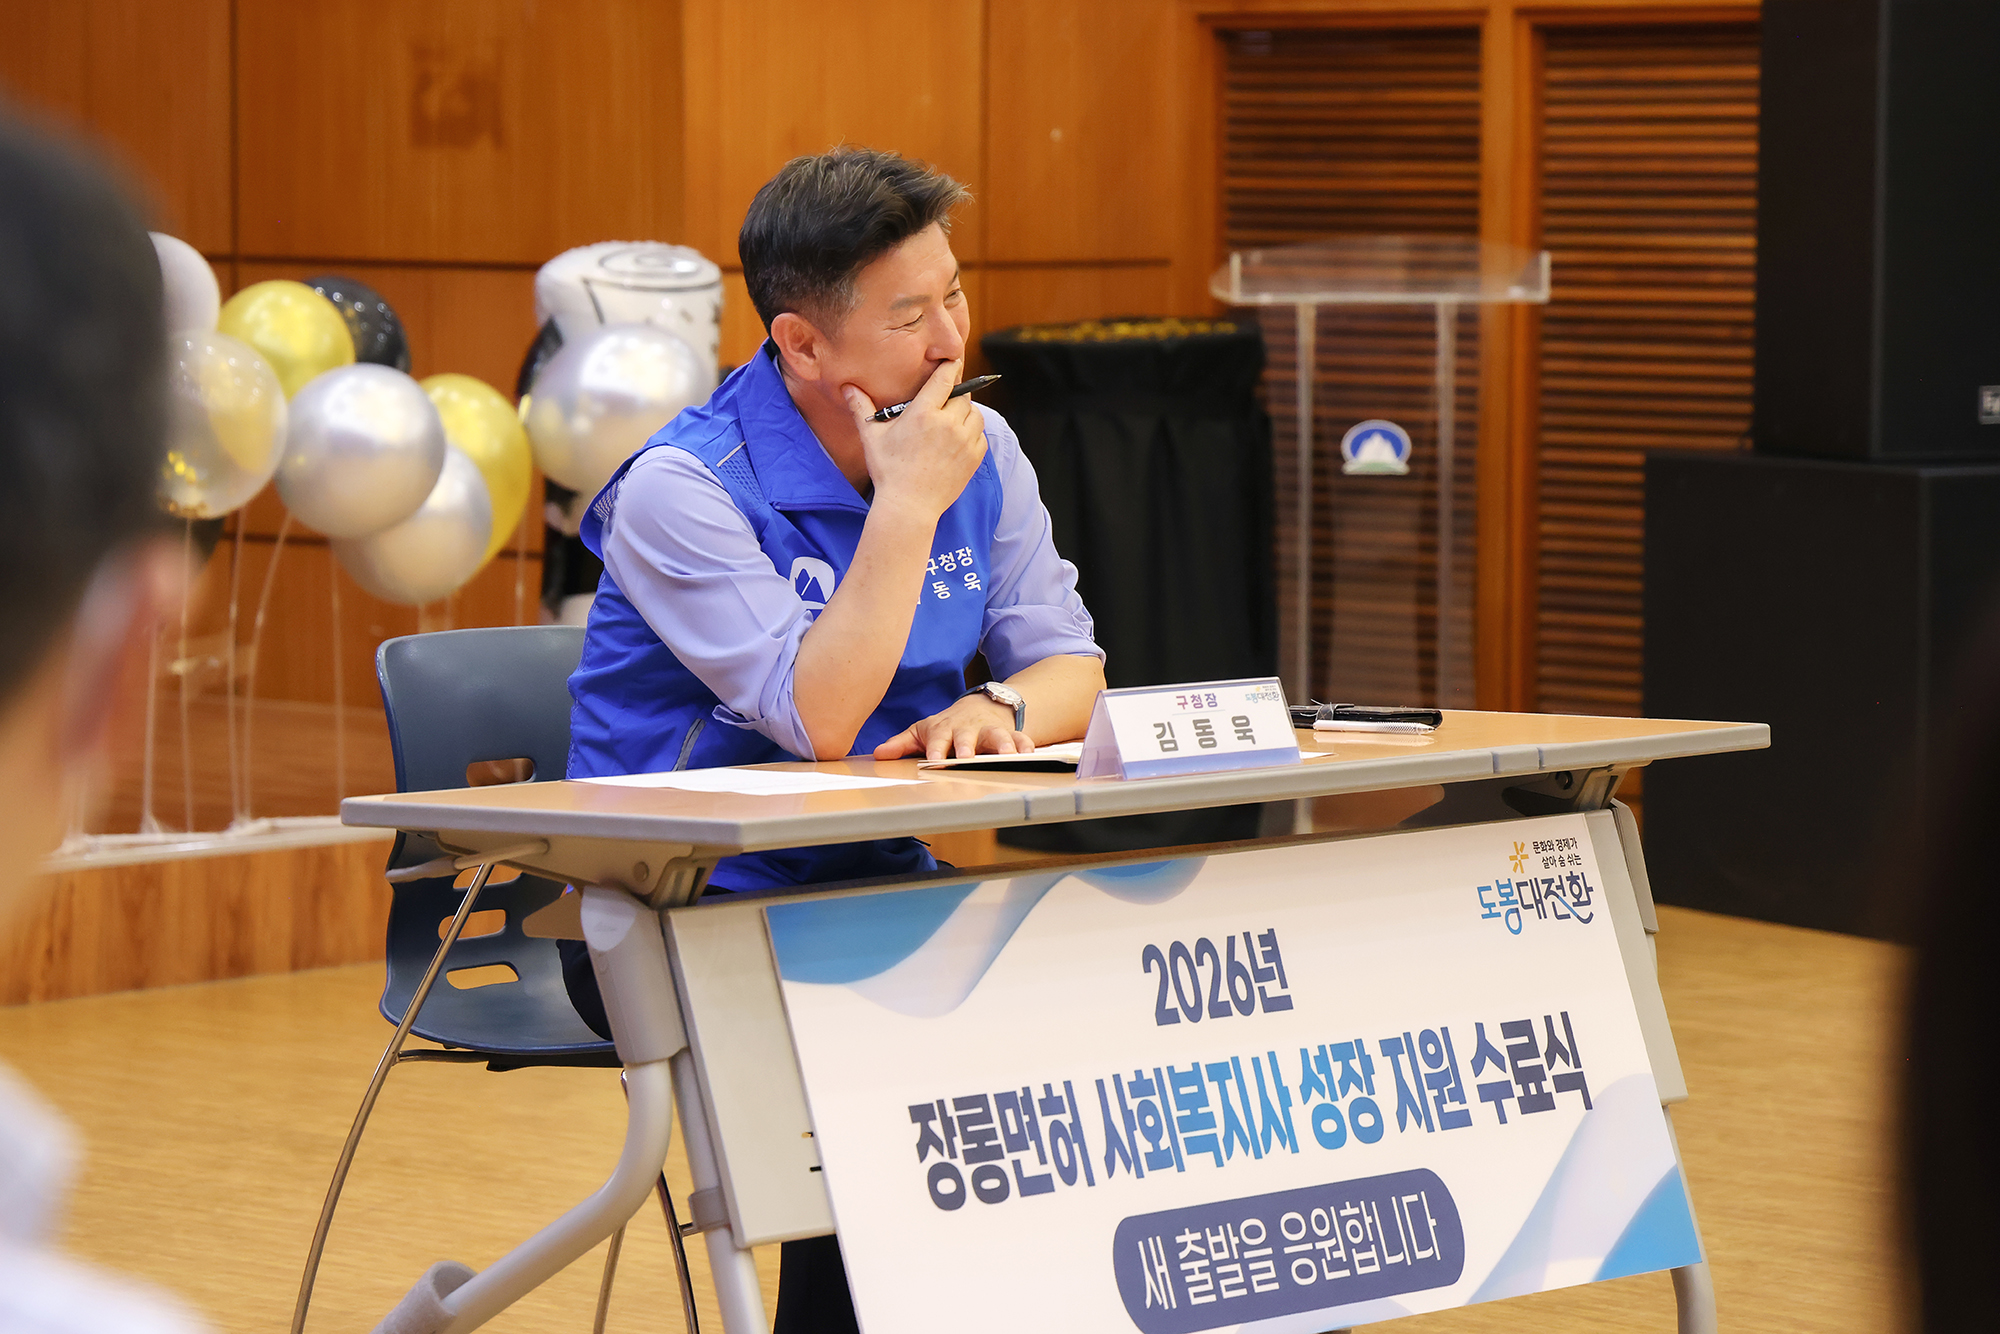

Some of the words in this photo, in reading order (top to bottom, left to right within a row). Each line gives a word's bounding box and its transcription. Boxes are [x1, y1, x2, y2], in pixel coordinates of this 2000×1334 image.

[925, 546, 974, 576] 구청장
[917, 572, 982, 605] 동욱
[1175, 692, 1218, 710] 구청장
[1532, 839, 1555, 854] 문화와
[1555, 836, 1578, 852] 경제가
[1541, 855, 1557, 869] 살아
[1558, 854, 1566, 867] 숨
[1566, 853, 1582, 866] 쉬는
[1476, 870, 1594, 935] 도봉대전환
[1141, 928, 1294, 1026] 2026년
[907, 1080, 1096, 1212] 장롱면허
[1095, 1051, 1300, 1179] 사회복지사
[1299, 1038, 1385, 1151] 성장
[1378, 1026, 1474, 1133] 지원
[1470, 1011, 1594, 1125] 수료식
[1137, 1235, 1178, 1311] 새
[1175, 1217, 1281, 1306] 출발을
[1279, 1190, 1442, 1286] 응원합니다
